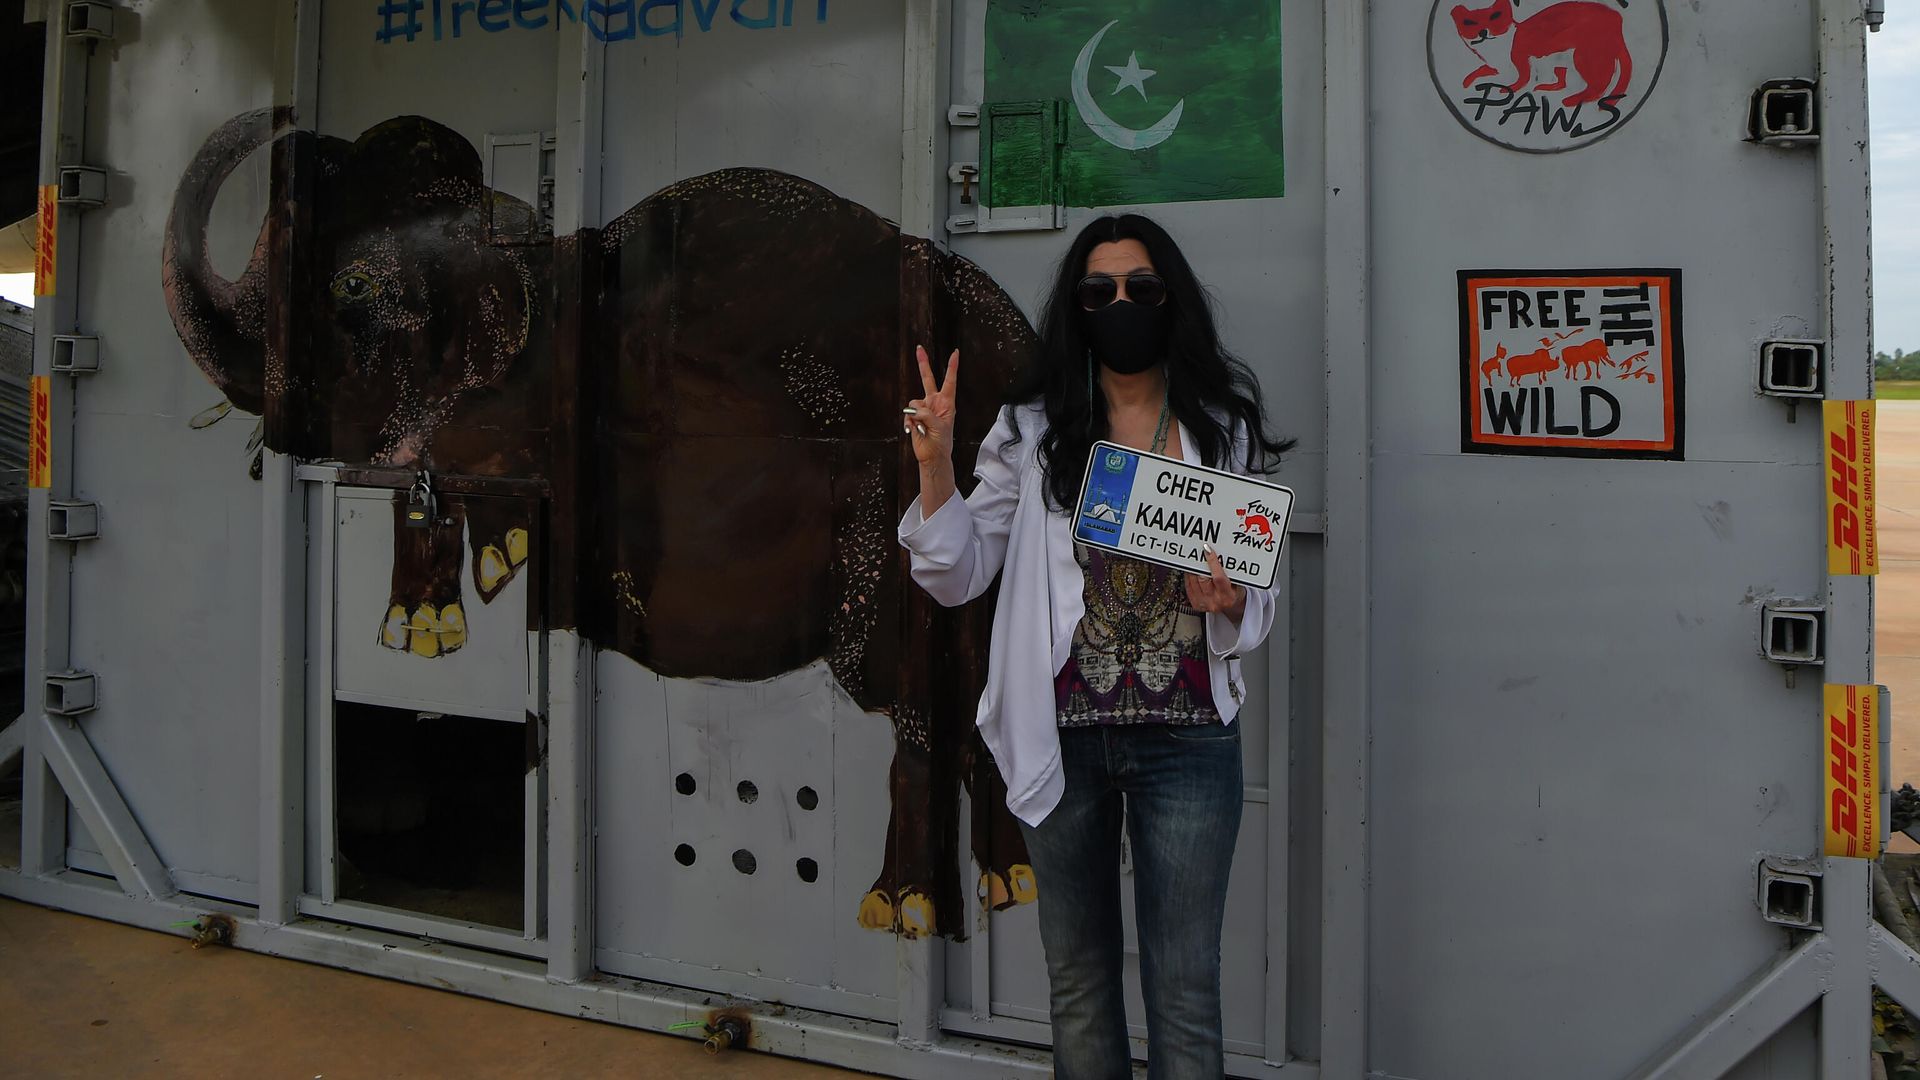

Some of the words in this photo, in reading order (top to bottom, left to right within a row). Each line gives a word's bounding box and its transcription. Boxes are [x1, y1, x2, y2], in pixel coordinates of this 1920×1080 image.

[1464, 82, 1627, 138] PAWS
[41, 201, 54, 280] DHL
[1481, 289, 1591, 330] FREE
[1600, 282, 1655, 347] THE
[36, 392, 48, 471] DHL
[1484, 385, 1621, 437] WILD
[1862, 409, 1870, 464] DELIVERED.
[1156, 471, 1215, 506] CHER
[1831, 424, 1859, 552] DHL
[1863, 465, 1872, 501] SIMPLY
[1135, 502, 1221, 544] KAAVAN
[1247, 499, 1281, 526] FOUR
[1863, 503, 1874, 567] EXCELLENCE.
[1232, 532, 1276, 552] PAWS
[1862, 695, 1871, 750] DELIVERED.
[1831, 708, 1857, 838] DHL
[1862, 752, 1871, 788] SIMPLY
[1862, 792, 1872, 852] EXCELLENCE.
